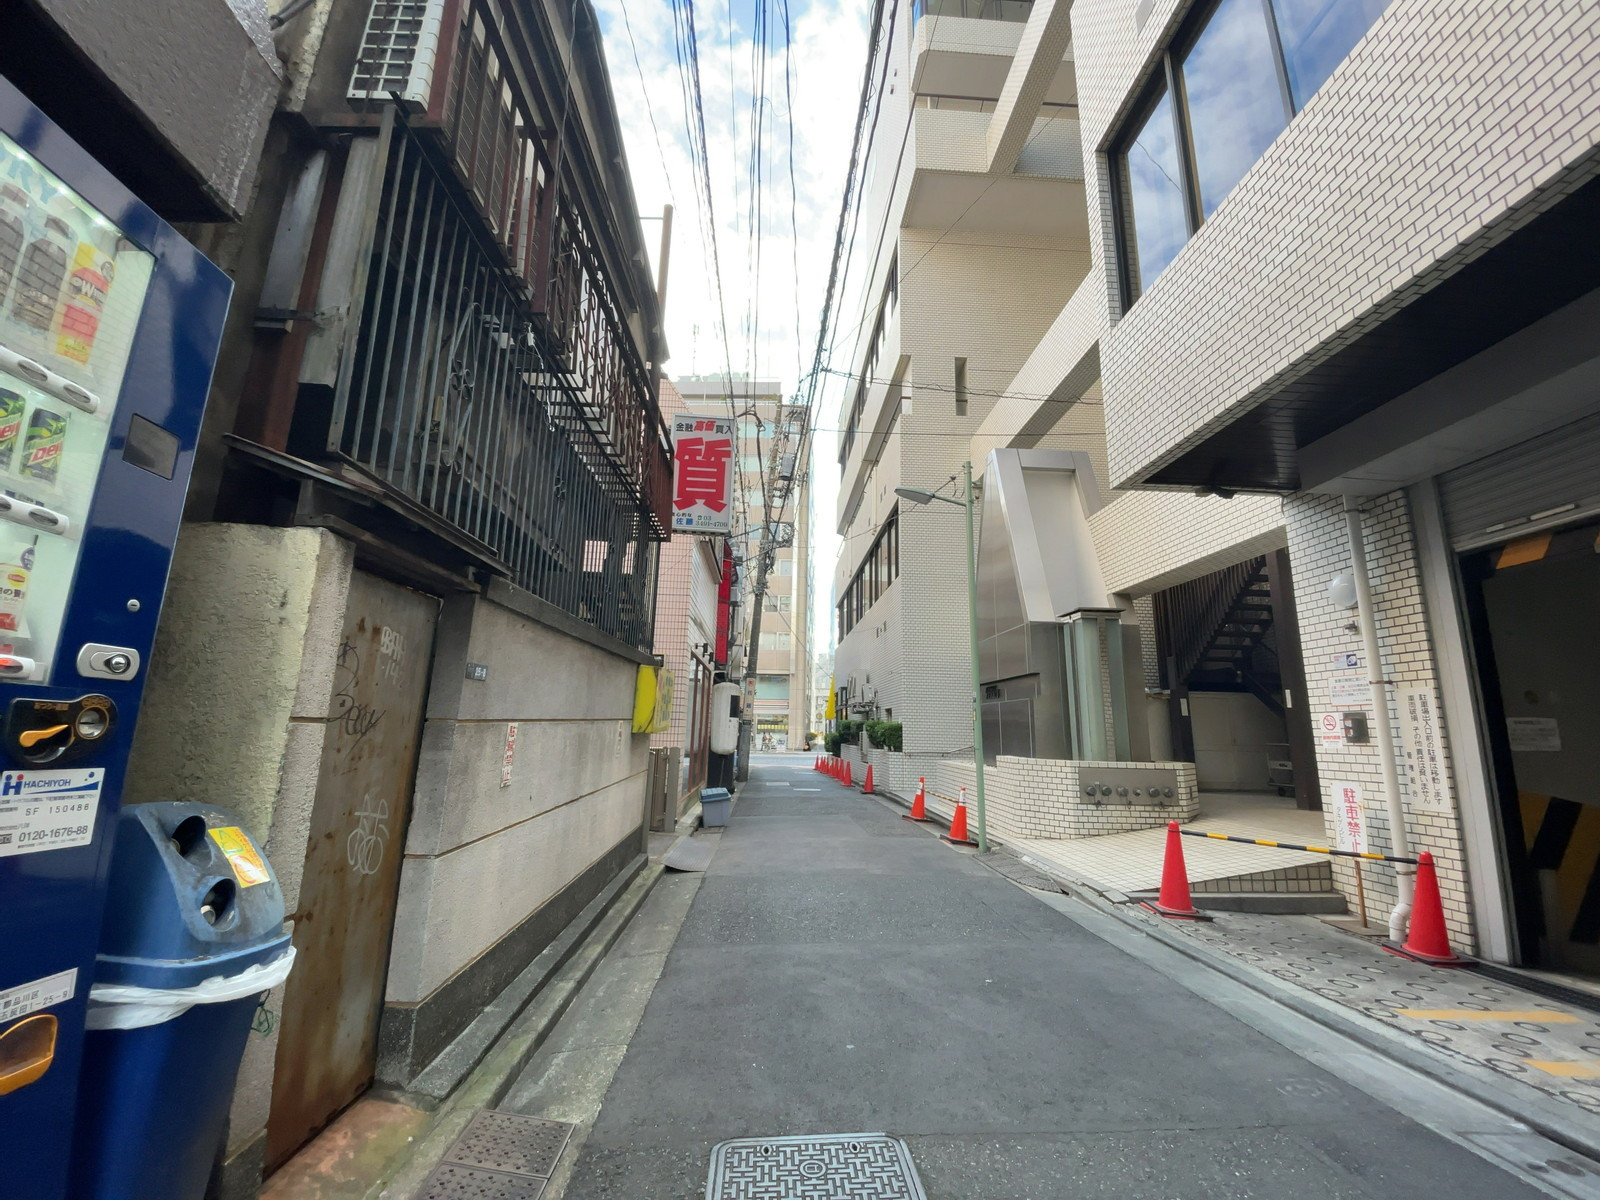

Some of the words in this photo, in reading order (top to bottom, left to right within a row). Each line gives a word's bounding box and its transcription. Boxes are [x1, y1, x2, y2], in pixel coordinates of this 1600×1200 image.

[672, 437, 732, 513] 質
[1418, 694, 1443, 804] 駐車場出入口前の駐車は移動します
[23, 779, 72, 789] HACHIYOH
[25, 807, 40, 817] SF
[49, 804, 90, 815] 150486
[1343, 787, 1362, 853] 駐車禁止
[19, 825, 89, 843] 0120-1676-88
